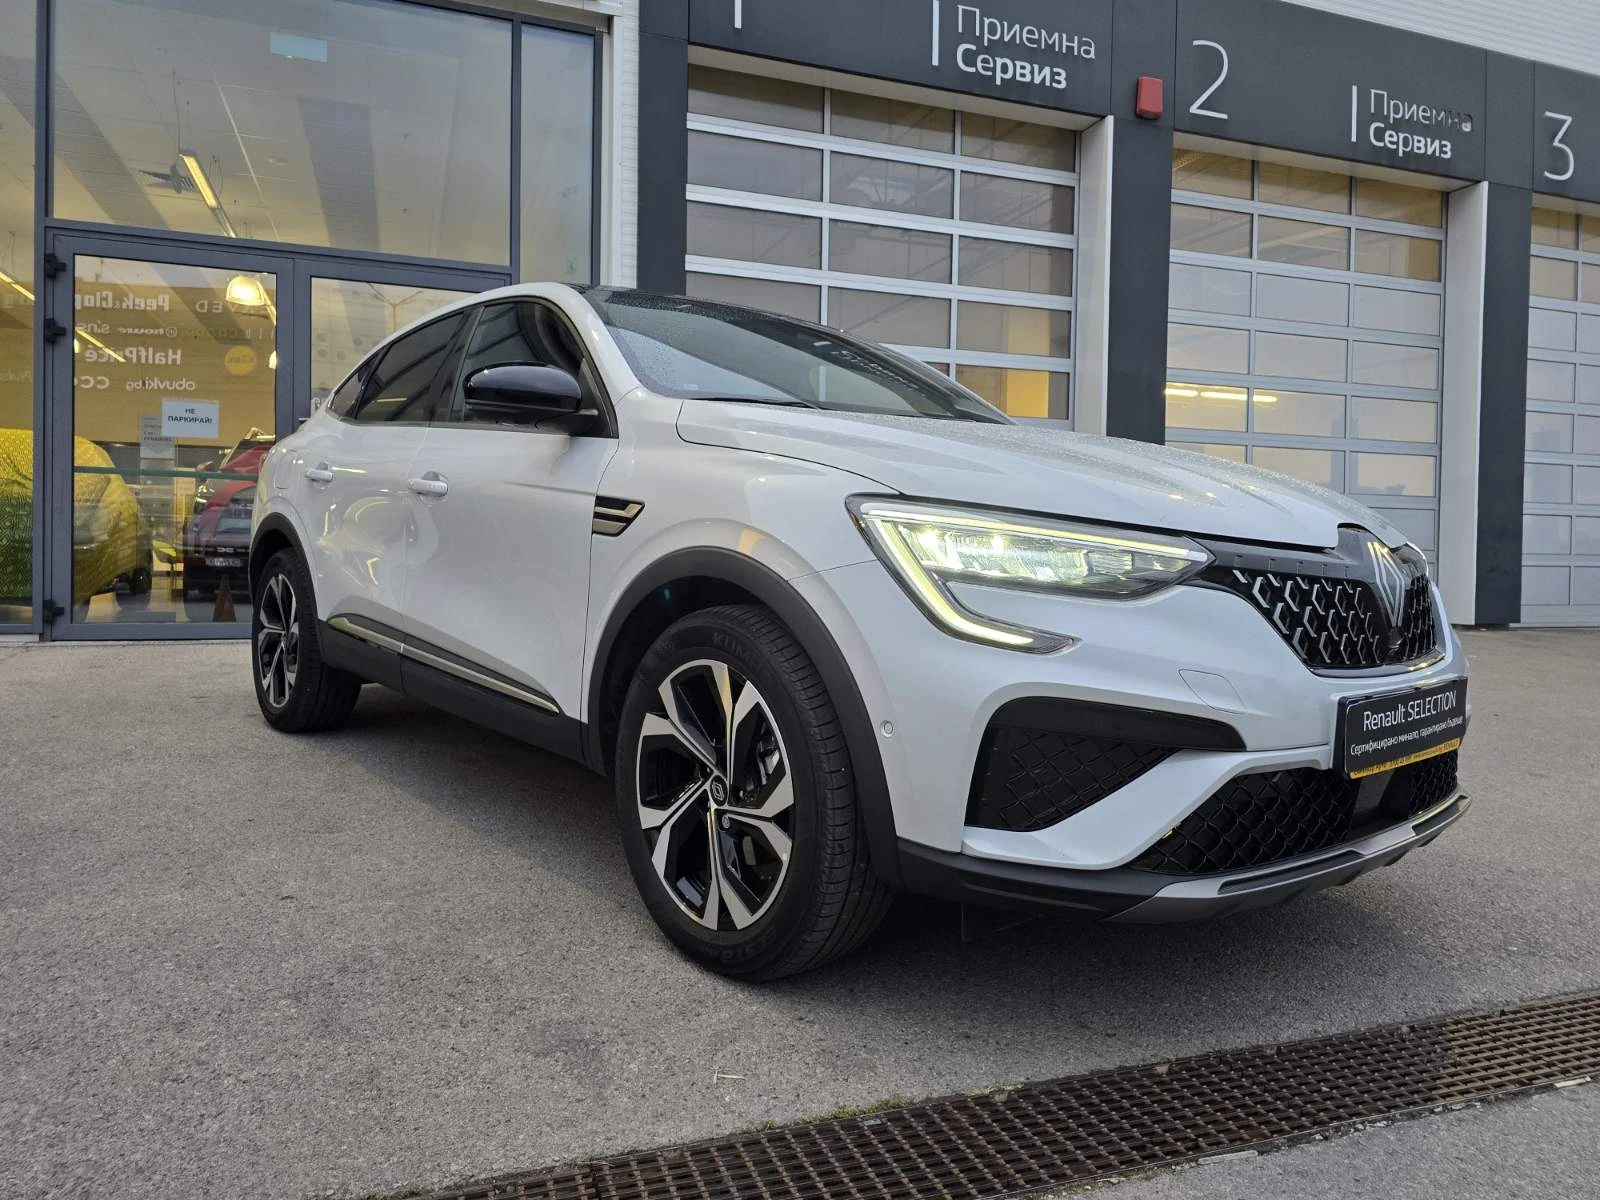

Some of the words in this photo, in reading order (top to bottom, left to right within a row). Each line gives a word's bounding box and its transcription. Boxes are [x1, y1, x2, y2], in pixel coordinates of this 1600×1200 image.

[956, 4, 1096, 59] Приемна
[956, 43, 1067, 89] Сервиз
[1189, 39, 1229, 119] 2
[1369, 121, 1452, 159] Сервиз
[1543, 110, 1575, 181] 3
[167, 415, 213, 424] ПАРКИРАЙ!
[1363, 704, 1405, 732] Renault
[1407, 690, 1457, 721] SELECTION
[1350, 734, 1398, 757] Сертифицирано
